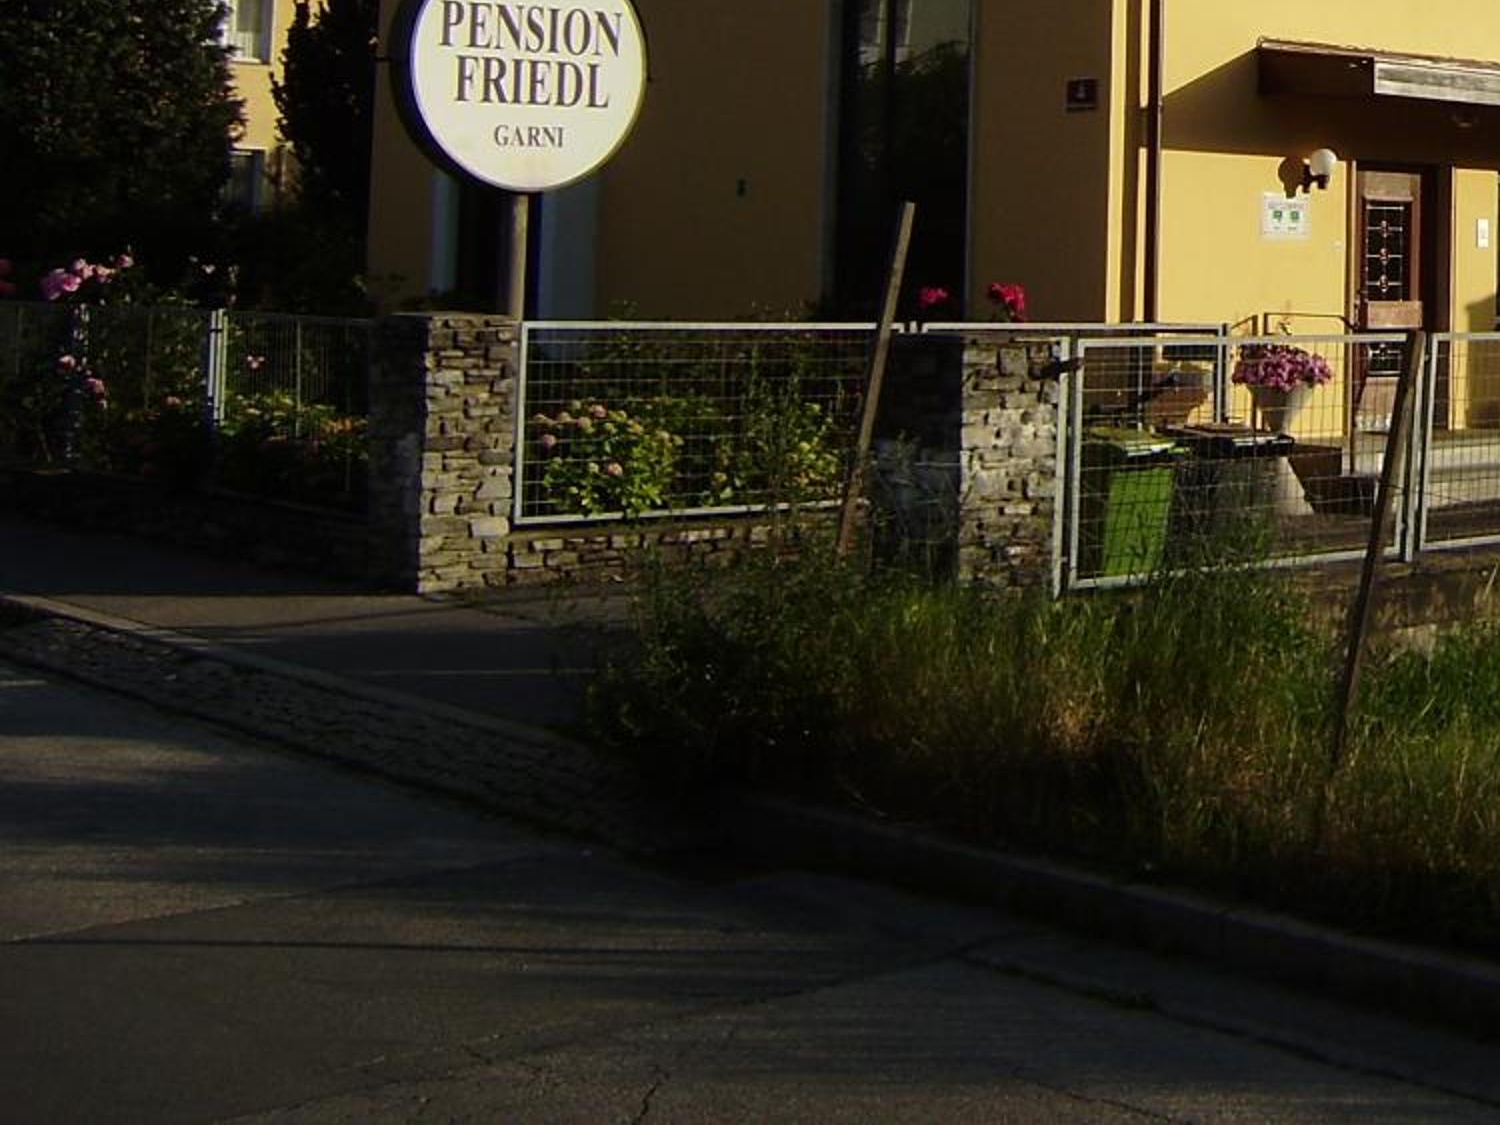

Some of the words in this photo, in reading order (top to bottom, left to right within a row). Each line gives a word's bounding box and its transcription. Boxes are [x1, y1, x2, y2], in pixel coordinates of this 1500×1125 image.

[439, 0, 622, 56] PENSION
[454, 55, 608, 108] FRIEDL
[493, 124, 564, 147] GARNI
